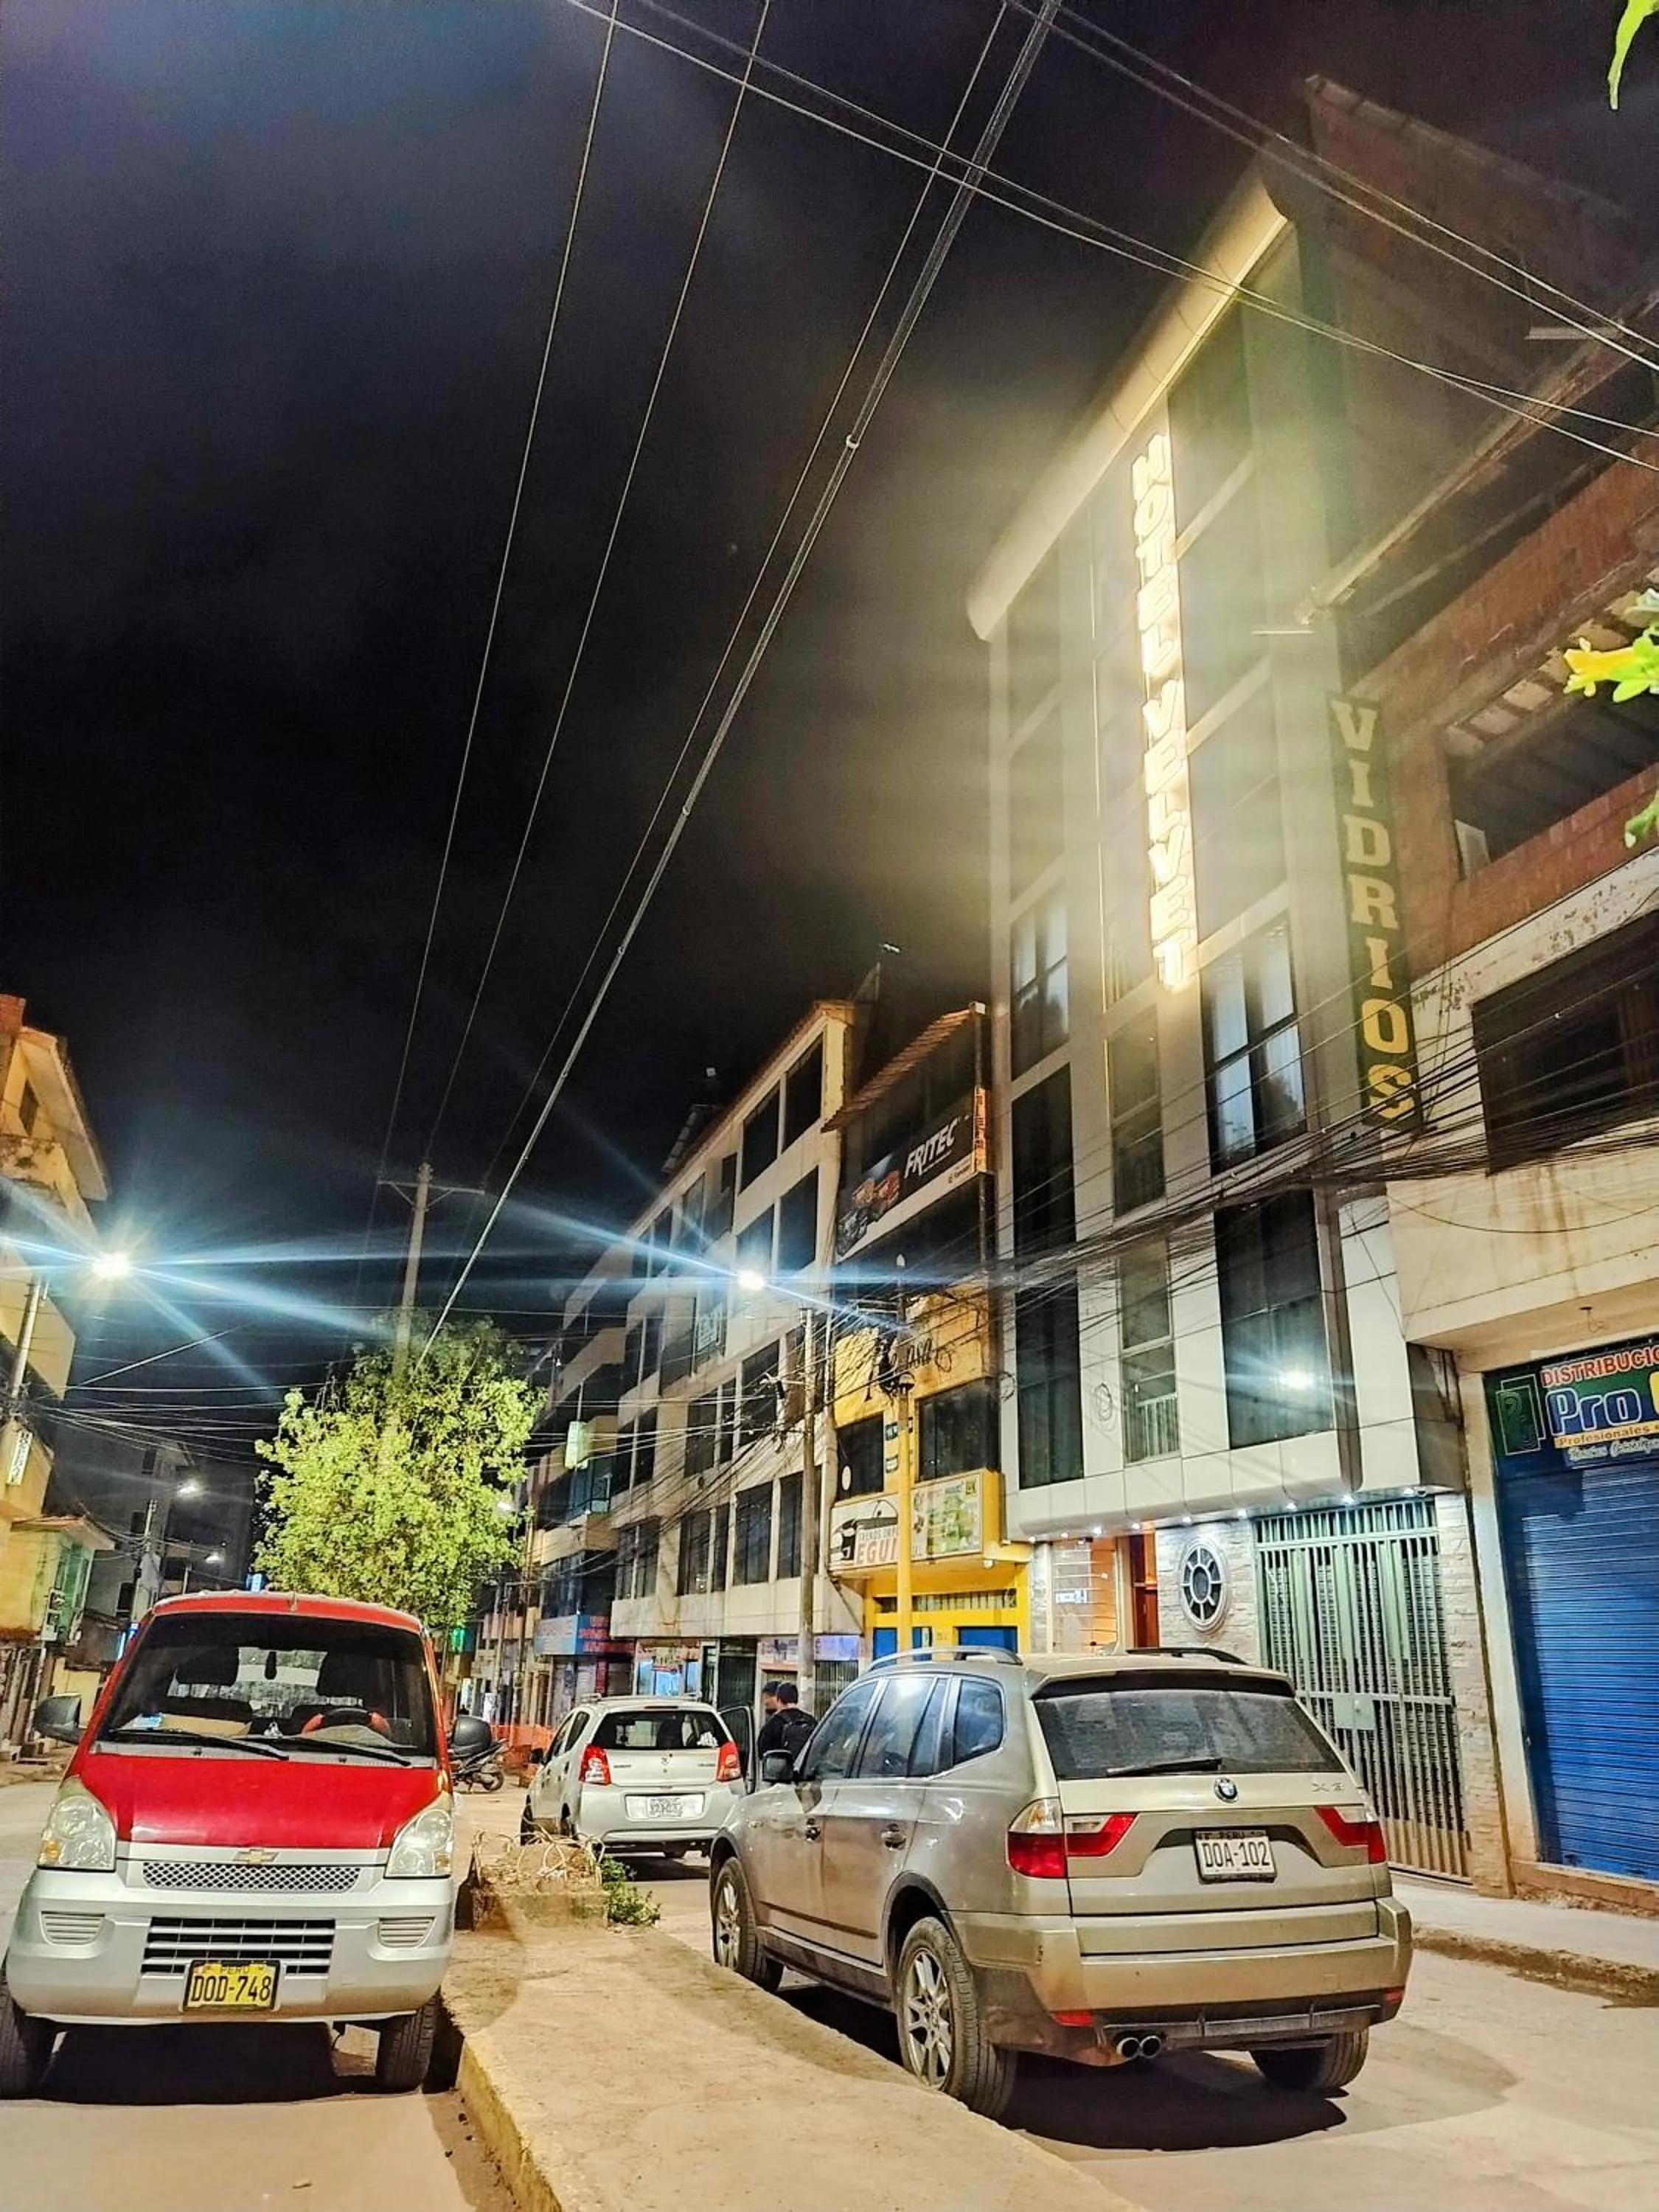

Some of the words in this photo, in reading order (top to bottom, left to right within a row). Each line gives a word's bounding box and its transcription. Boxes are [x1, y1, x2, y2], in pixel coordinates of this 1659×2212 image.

[1132, 434, 1179, 675] HOTEL
[1143, 678, 1192, 992] VELVET
[1331, 700, 1416, 1119] VIDRIOS
[904, 1118, 958, 1179] FRITEC
[1545, 1388, 1642, 1436] Pro
[1557, 1425, 1650, 1446] Profesionales
[1202, 1841, 1270, 1868] DOA-102
[191, 1975, 271, 2001] DOD-748
